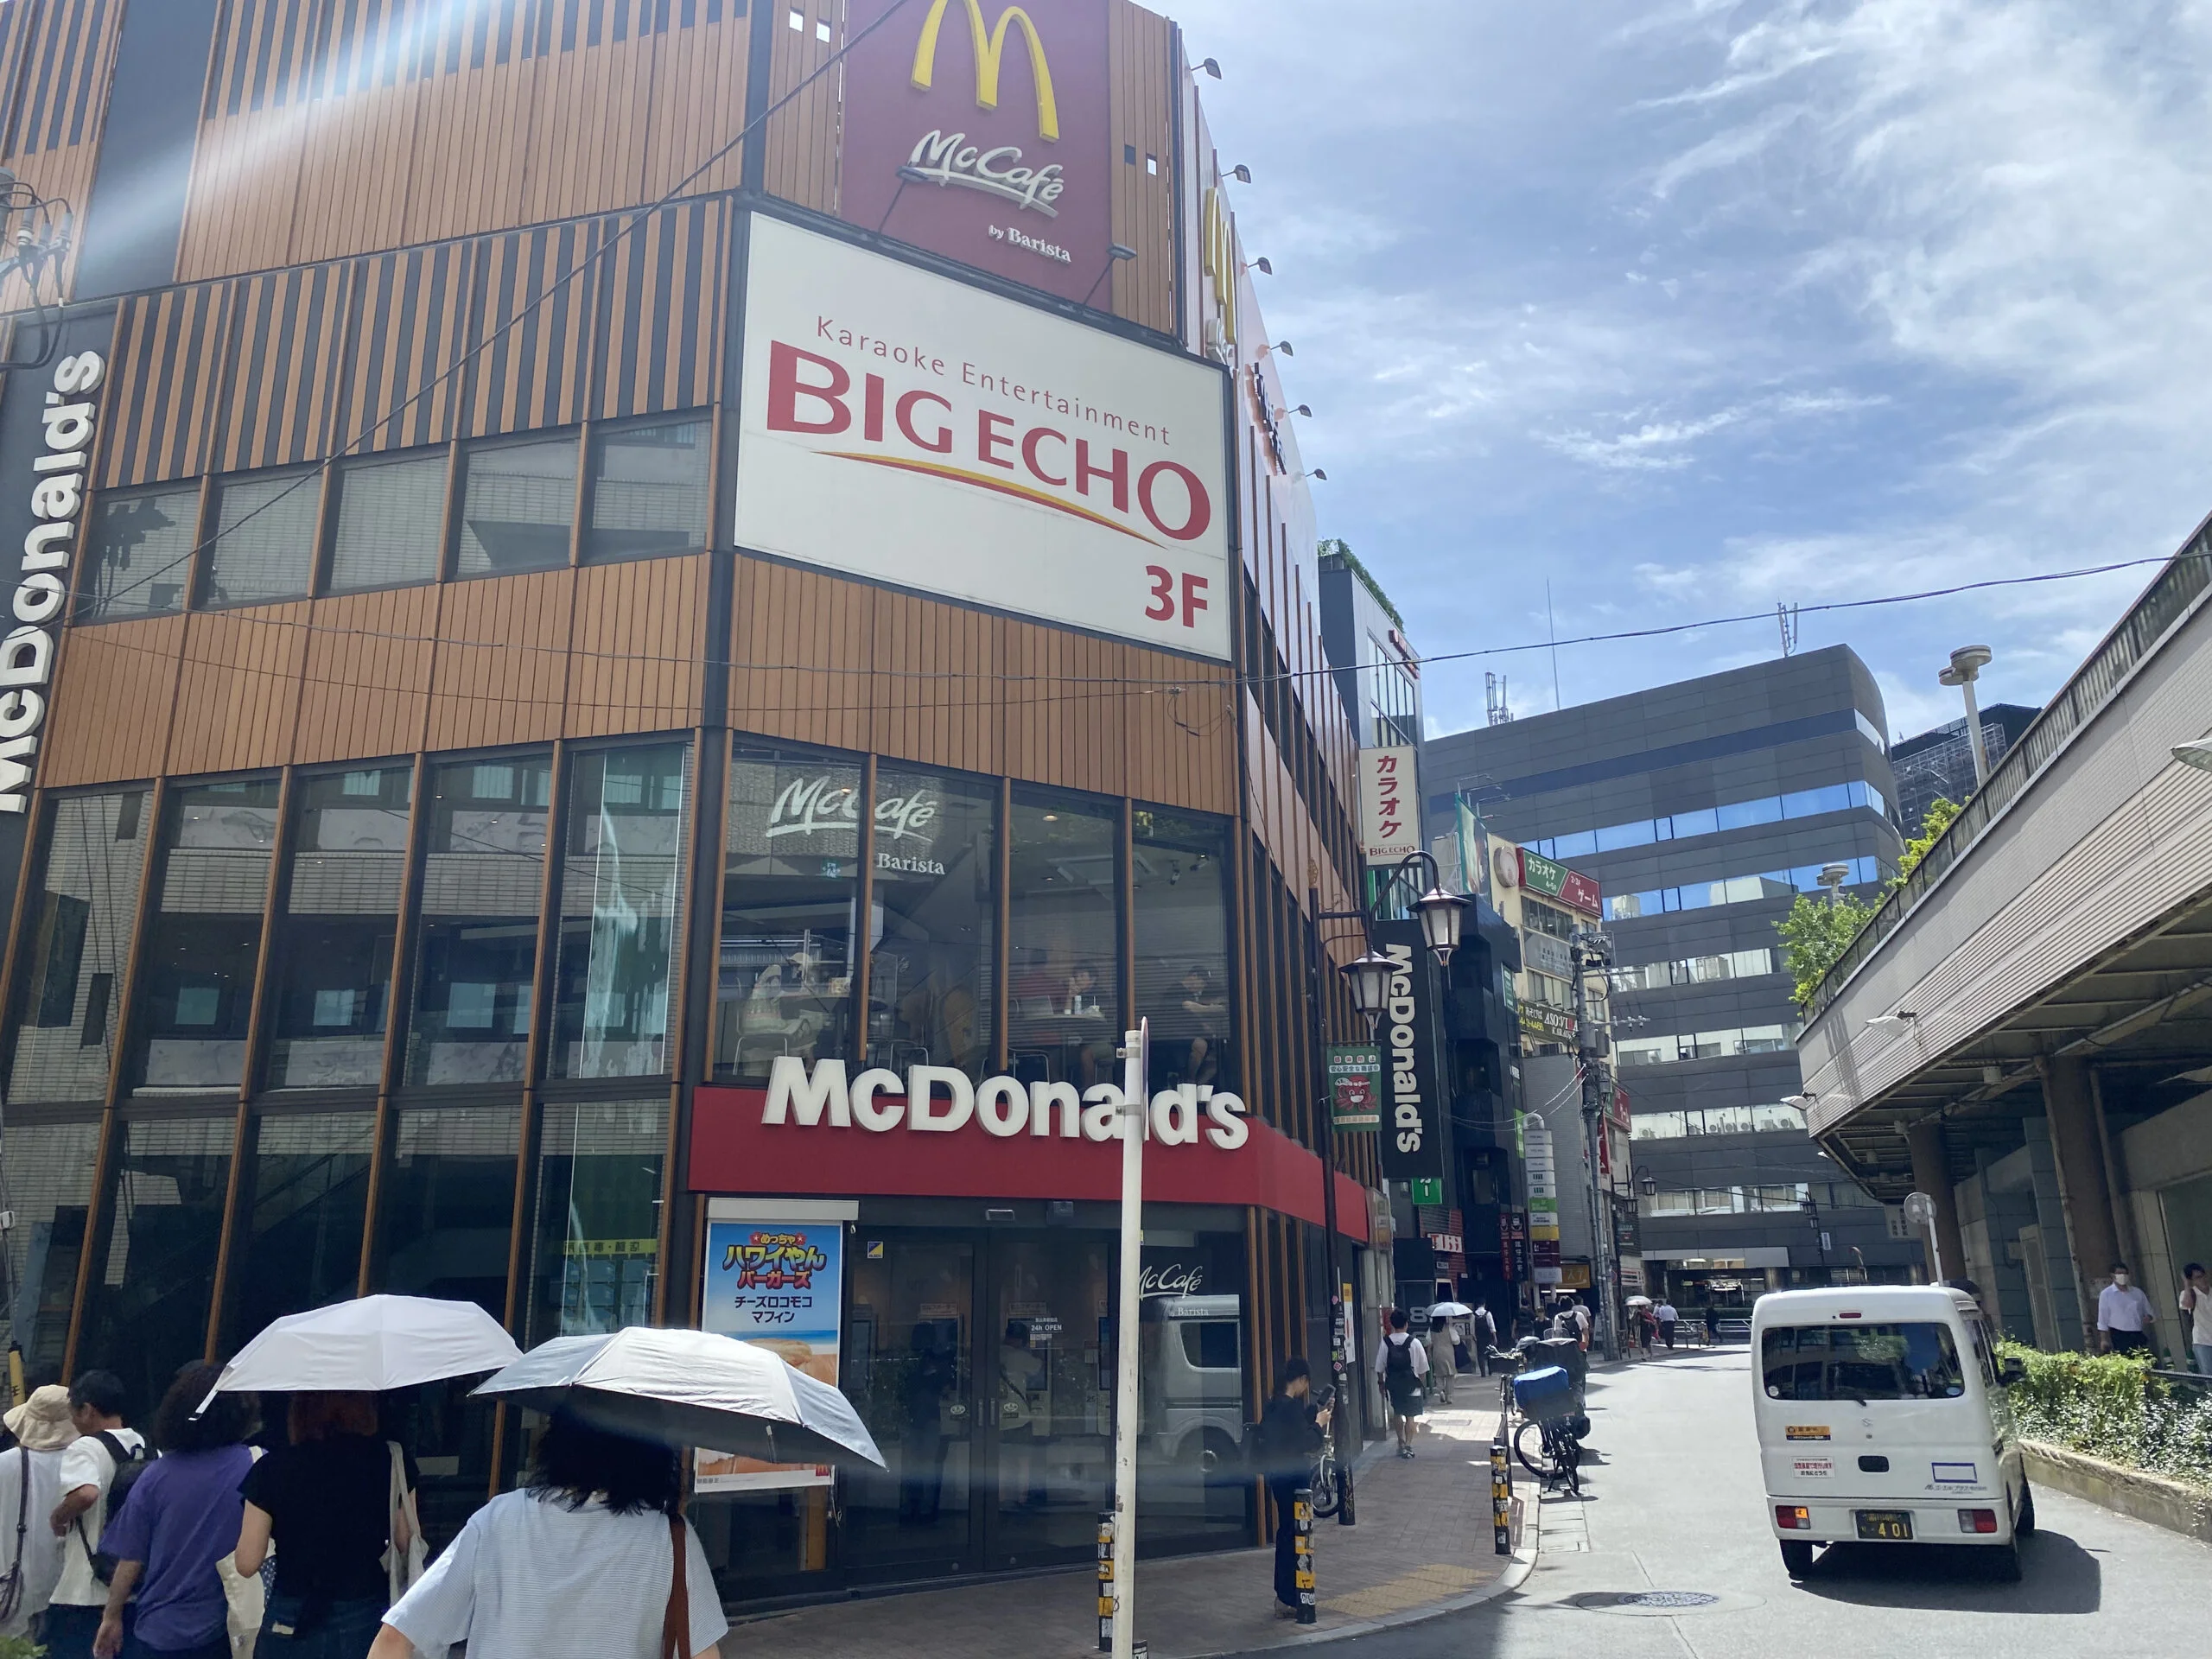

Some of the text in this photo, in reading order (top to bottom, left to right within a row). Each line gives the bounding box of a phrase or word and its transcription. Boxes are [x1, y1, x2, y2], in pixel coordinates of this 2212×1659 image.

[907, 130, 1065, 212] McCafé
[988, 225, 1072, 264] by Barista
[817, 315, 945, 377] Karaoke
[962, 362, 1171, 446] Entertainment
[766, 339, 953, 454] BIG
[977, 408, 1211, 542] ECHO
[1143, 563, 1209, 629] 3F
[1376, 755, 1402, 839] カラオケ
[876, 852, 946, 875] Barista
[1370, 845, 1416, 857] BIG ECHO
[1528, 856, 1556, 880] カラオケ
[1577, 888, 1599, 909] ゲーム
[1384, 943, 1423, 1154] McDonald's
[761, 1055, 1249, 1151] McDonad's
[760, 1232, 797, 1245] めっちゃ
[722, 1244, 827, 1272] ハワイやん
[737, 1269, 813, 1290] バーガーズ
[734, 1295, 813, 1309] チーズロコモコ
[1178, 1306, 1209, 1316] Barista
[752, 1311, 796, 1324] マフィン
